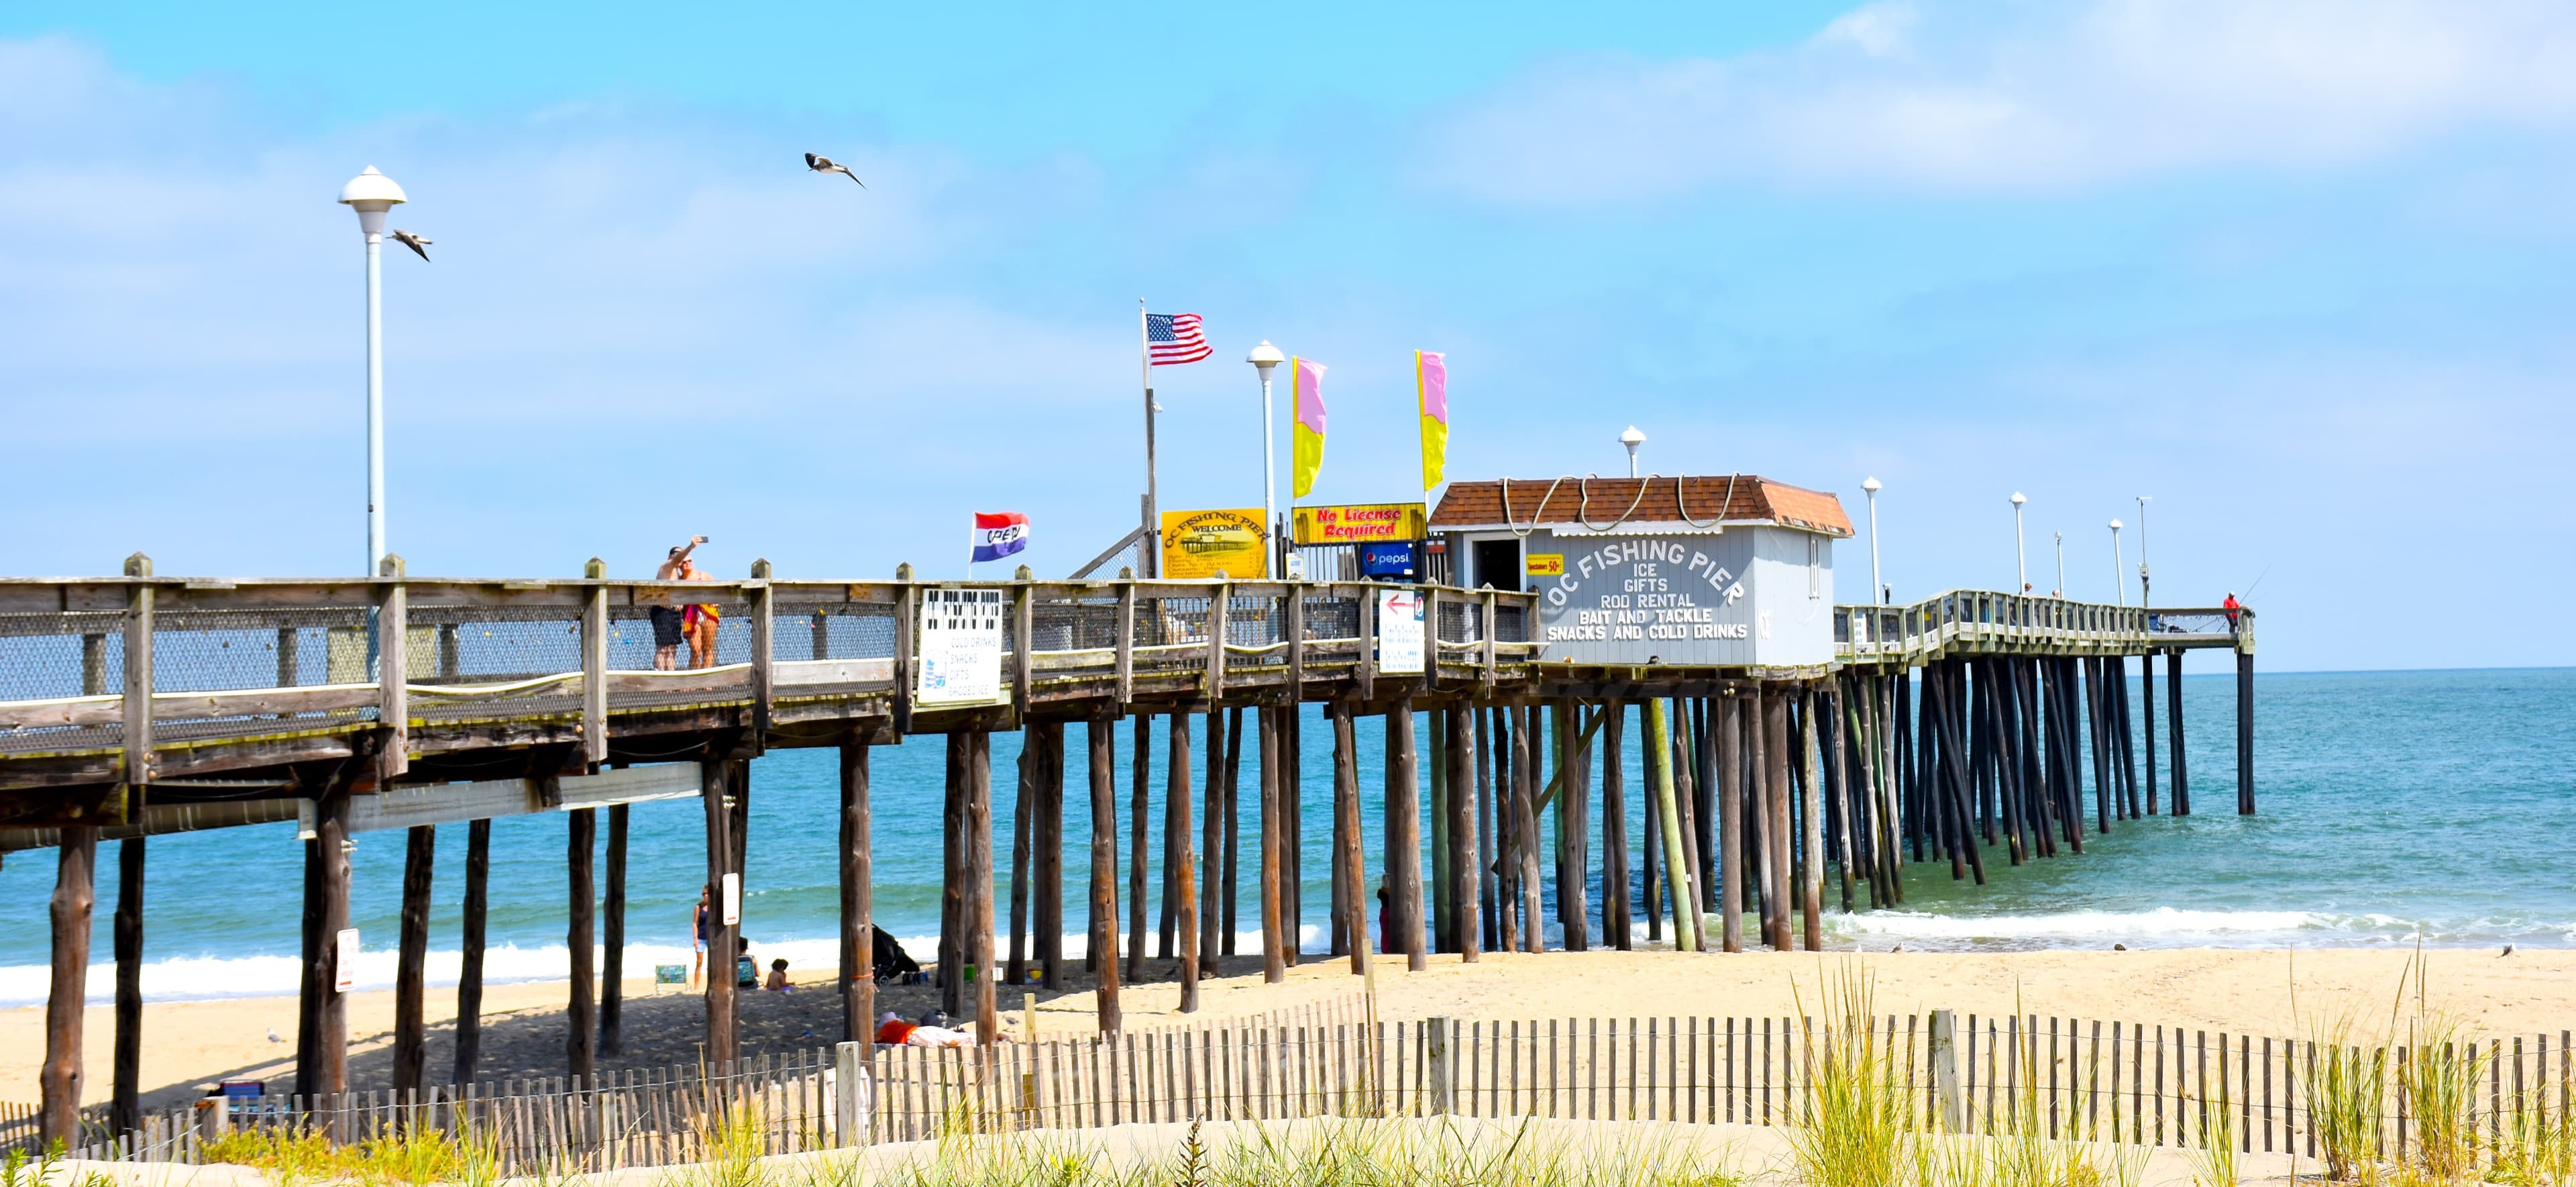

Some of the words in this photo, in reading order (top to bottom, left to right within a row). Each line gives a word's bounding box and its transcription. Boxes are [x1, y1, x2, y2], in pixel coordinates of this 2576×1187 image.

[1317, 509, 1337, 523] No
[1344, 507, 1401, 522] License
[987, 525, 1021, 544] OPEN
[1165, 529, 1181, 549] OC
[1178, 511, 1236, 531] FISHING
[1240, 515, 1267, 546] PIER
[1191, 524, 1242, 533] WELCOME
[1324, 522, 1396, 539] Required
[1379, 552, 1409, 565] pepsi
[1547, 572, 1578, 606] OC
[1577, 539, 1685, 580] FISHING
[1688, 551, 1744, 605] PIER
[1634, 563, 1657, 577] ICE
[1624, 578, 1668, 592] GIFTS
[1601, 594, 1629, 609] ROD
[1638, 593, 1695, 608] RENTAL
[1579, 609, 1612, 625] BAIT
[1617, 609, 1646, 624] AND
[1656, 608, 1713, 623] TACKLE
[1547, 625, 1607, 641] SNACKS
[1613, 625, 1642, 640] AND
[1649, 624, 1687, 639] COLD
[1694, 623, 1748, 639] DRINKS
[951, 637, 969, 648] COLD
[971, 636, 997, 648] DRINKS
[951, 653, 977, 664] SNACKS
[949, 670, 969, 680] GIFTS
